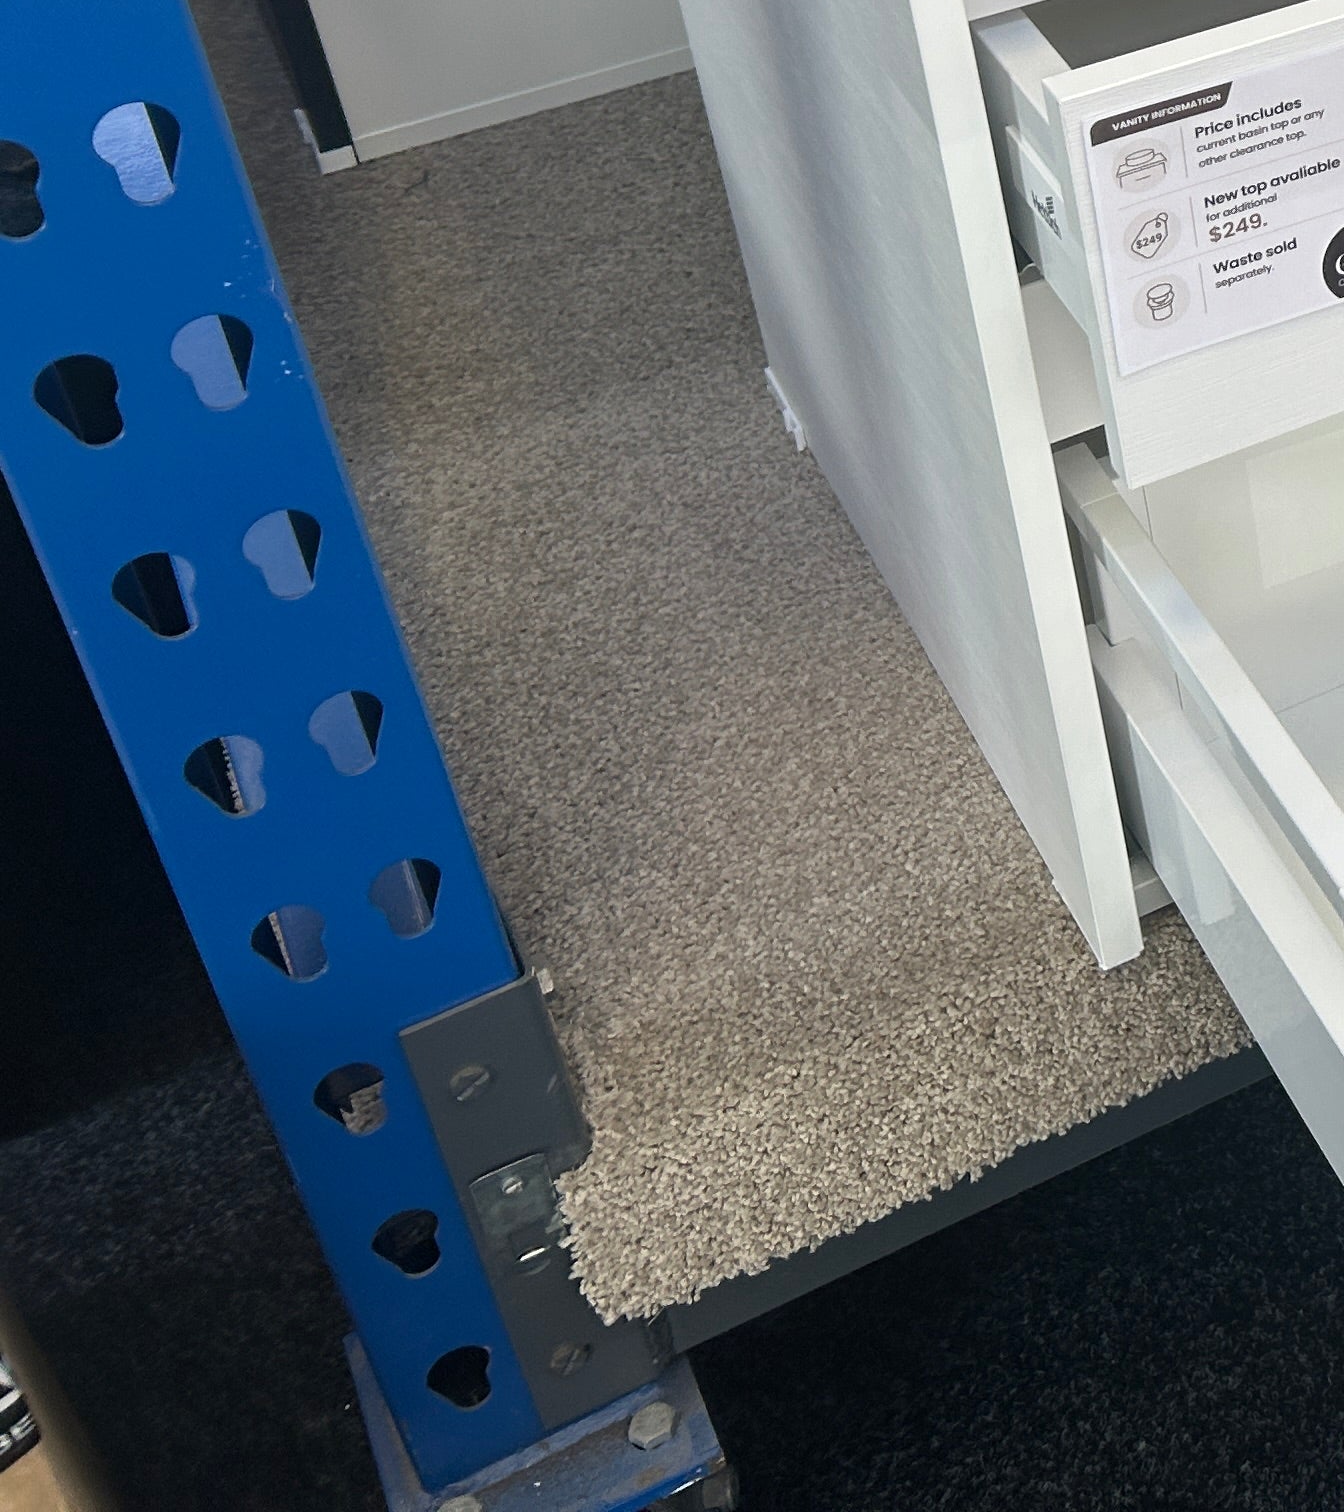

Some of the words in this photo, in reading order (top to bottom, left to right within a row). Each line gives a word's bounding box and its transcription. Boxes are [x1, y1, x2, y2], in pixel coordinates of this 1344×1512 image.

[1112, 114, 1149, 131] VANITY
[1151, 92, 1221, 119] INFORMATION
[1194, 119, 1234, 139] Price
[1236, 98, 1302, 127] includes
[1196, 134, 1237, 153] current
[1238, 124, 1269, 141] basin
[1270, 119, 1289, 132] top
[1290, 115, 1302, 125] or
[1303, 108, 1325, 121] any
[1198, 153, 1228, 168] other
[1229, 136, 1284, 160] clearance
[1204, 188, 1239, 209] New
[1240, 180, 1268, 197] top
[1206, 211, 1220, 223] for
[1223, 193, 1278, 218] additional
[1136, 232, 1163, 251] $249
[1209, 212, 1269, 243] $249.
[1213, 250, 1263, 275] Waste
[1265, 237, 1298, 259] sold
[1215, 263, 1275, 289] separately.
